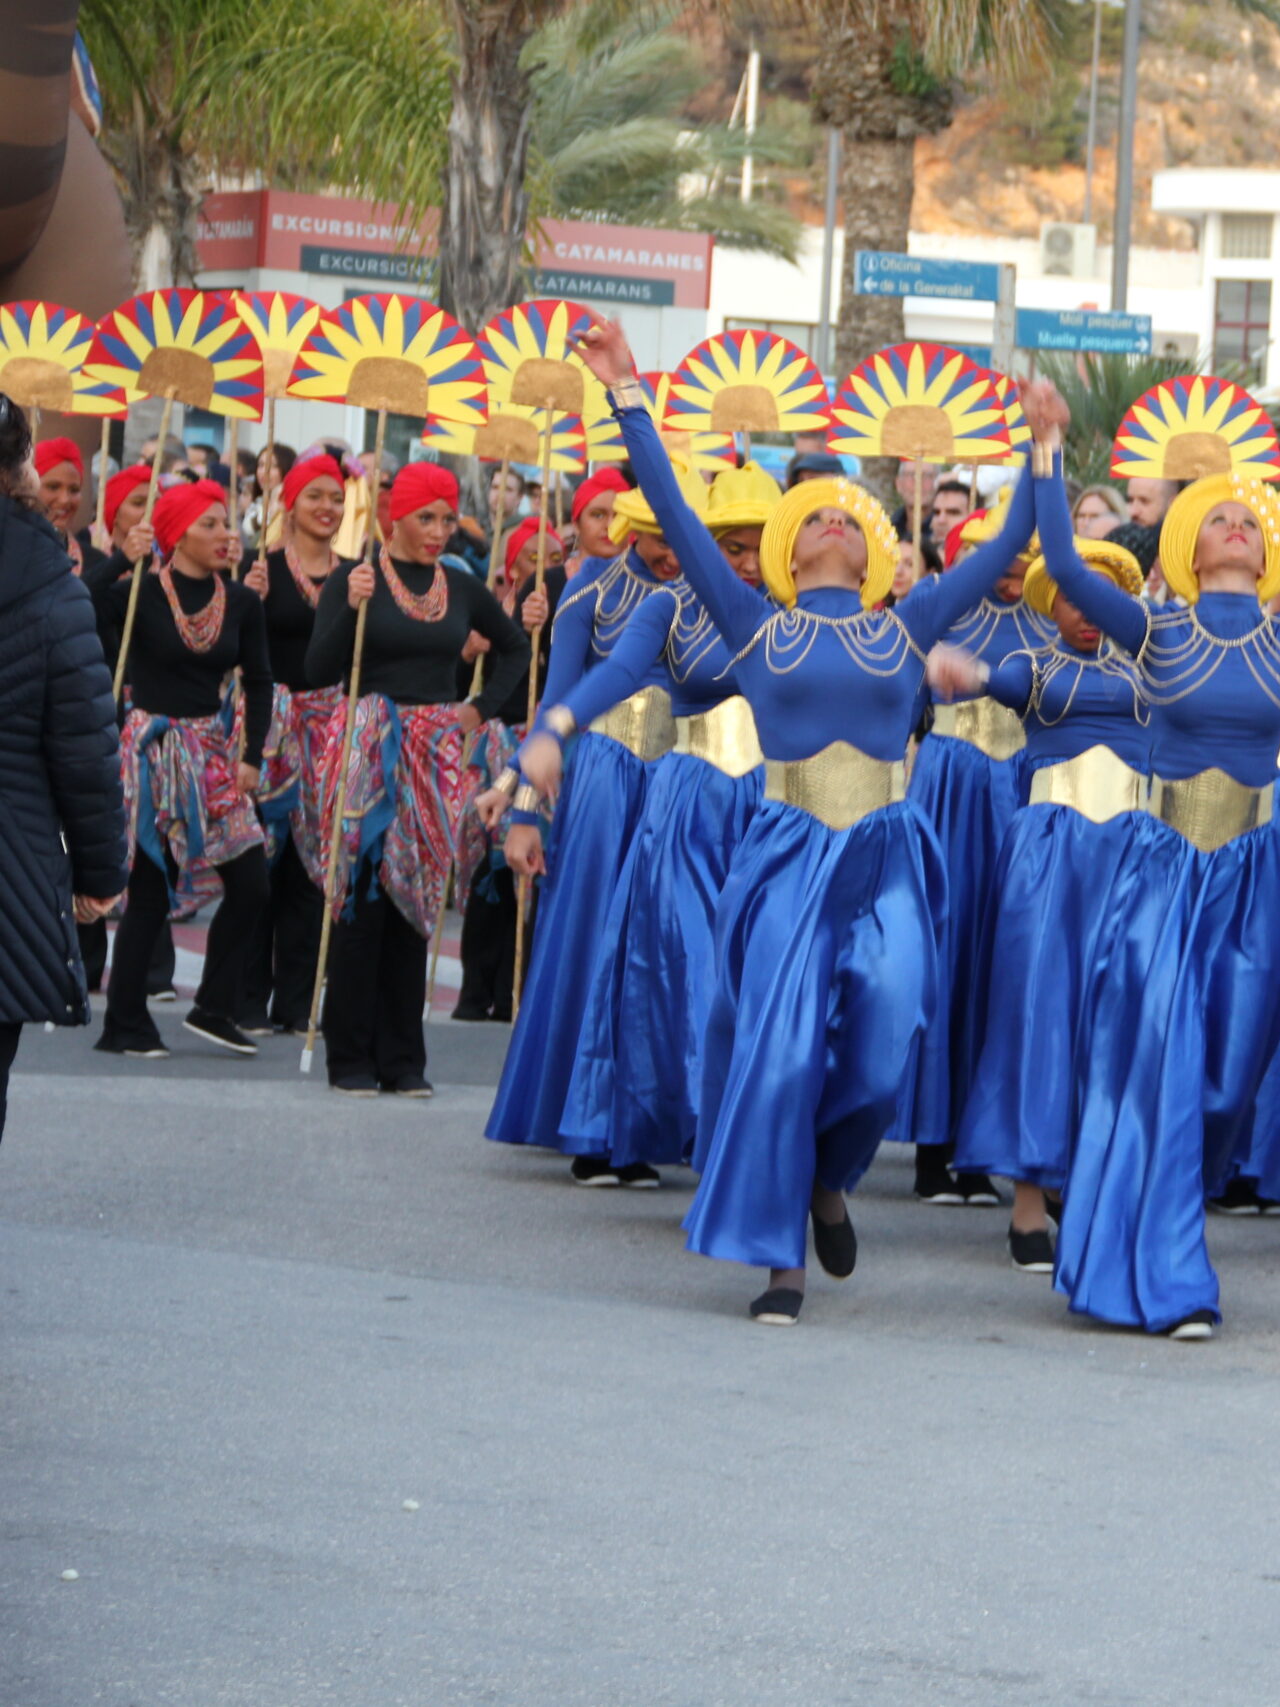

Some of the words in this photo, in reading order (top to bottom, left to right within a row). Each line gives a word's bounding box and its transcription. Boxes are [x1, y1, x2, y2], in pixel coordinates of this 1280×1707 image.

[555, 242, 705, 272] CATAMARANES
[880, 256, 922, 274] Oficina
[534, 275, 652, 300] CATAMARANS
[880, 280, 894, 292] de
[914, 280, 974, 298] Generalitat
[1038, 331, 1077, 347] Muelle
[1080, 335, 1133, 352] pesquero
